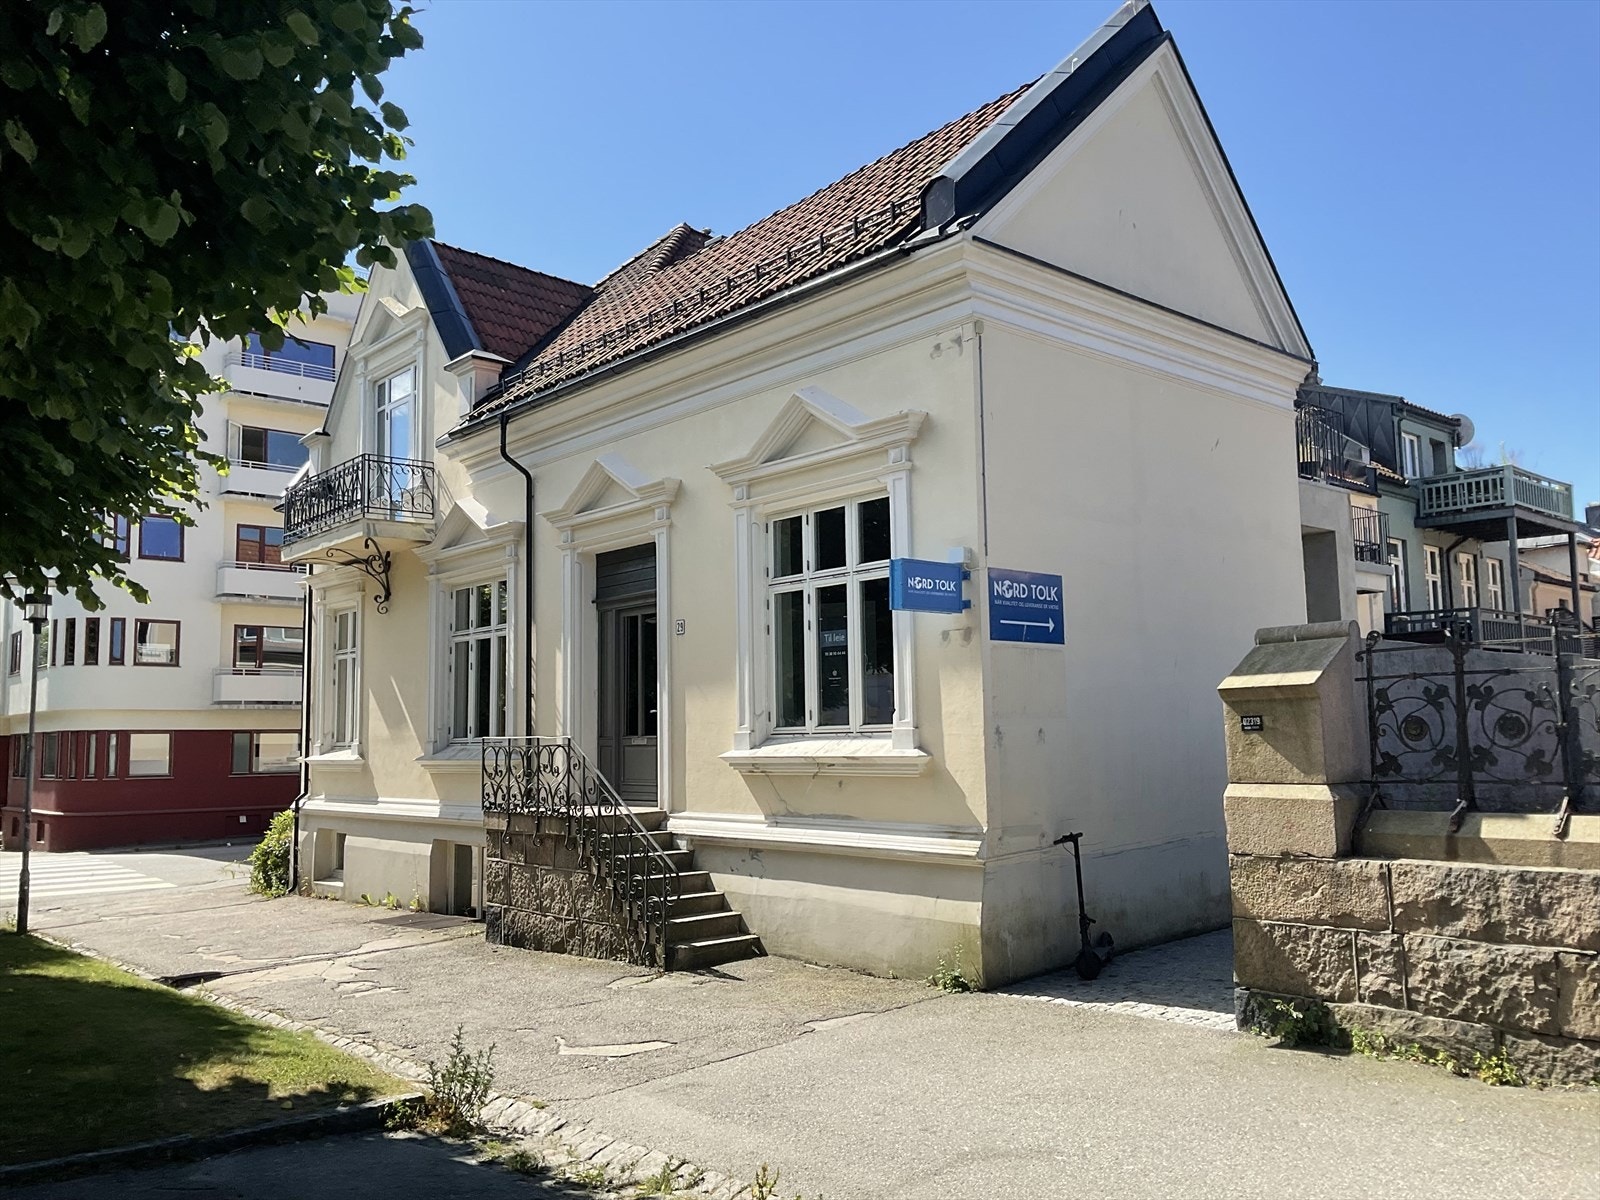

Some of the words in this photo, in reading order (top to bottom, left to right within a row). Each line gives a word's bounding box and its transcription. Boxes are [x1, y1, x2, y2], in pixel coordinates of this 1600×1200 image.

[935, 579, 956, 591] TOLK
[1030, 584, 1059, 602] TOLK
[677, 622, 683, 632] 29
[824, 633, 832, 642] Til
[833, 633, 845, 641] leie
